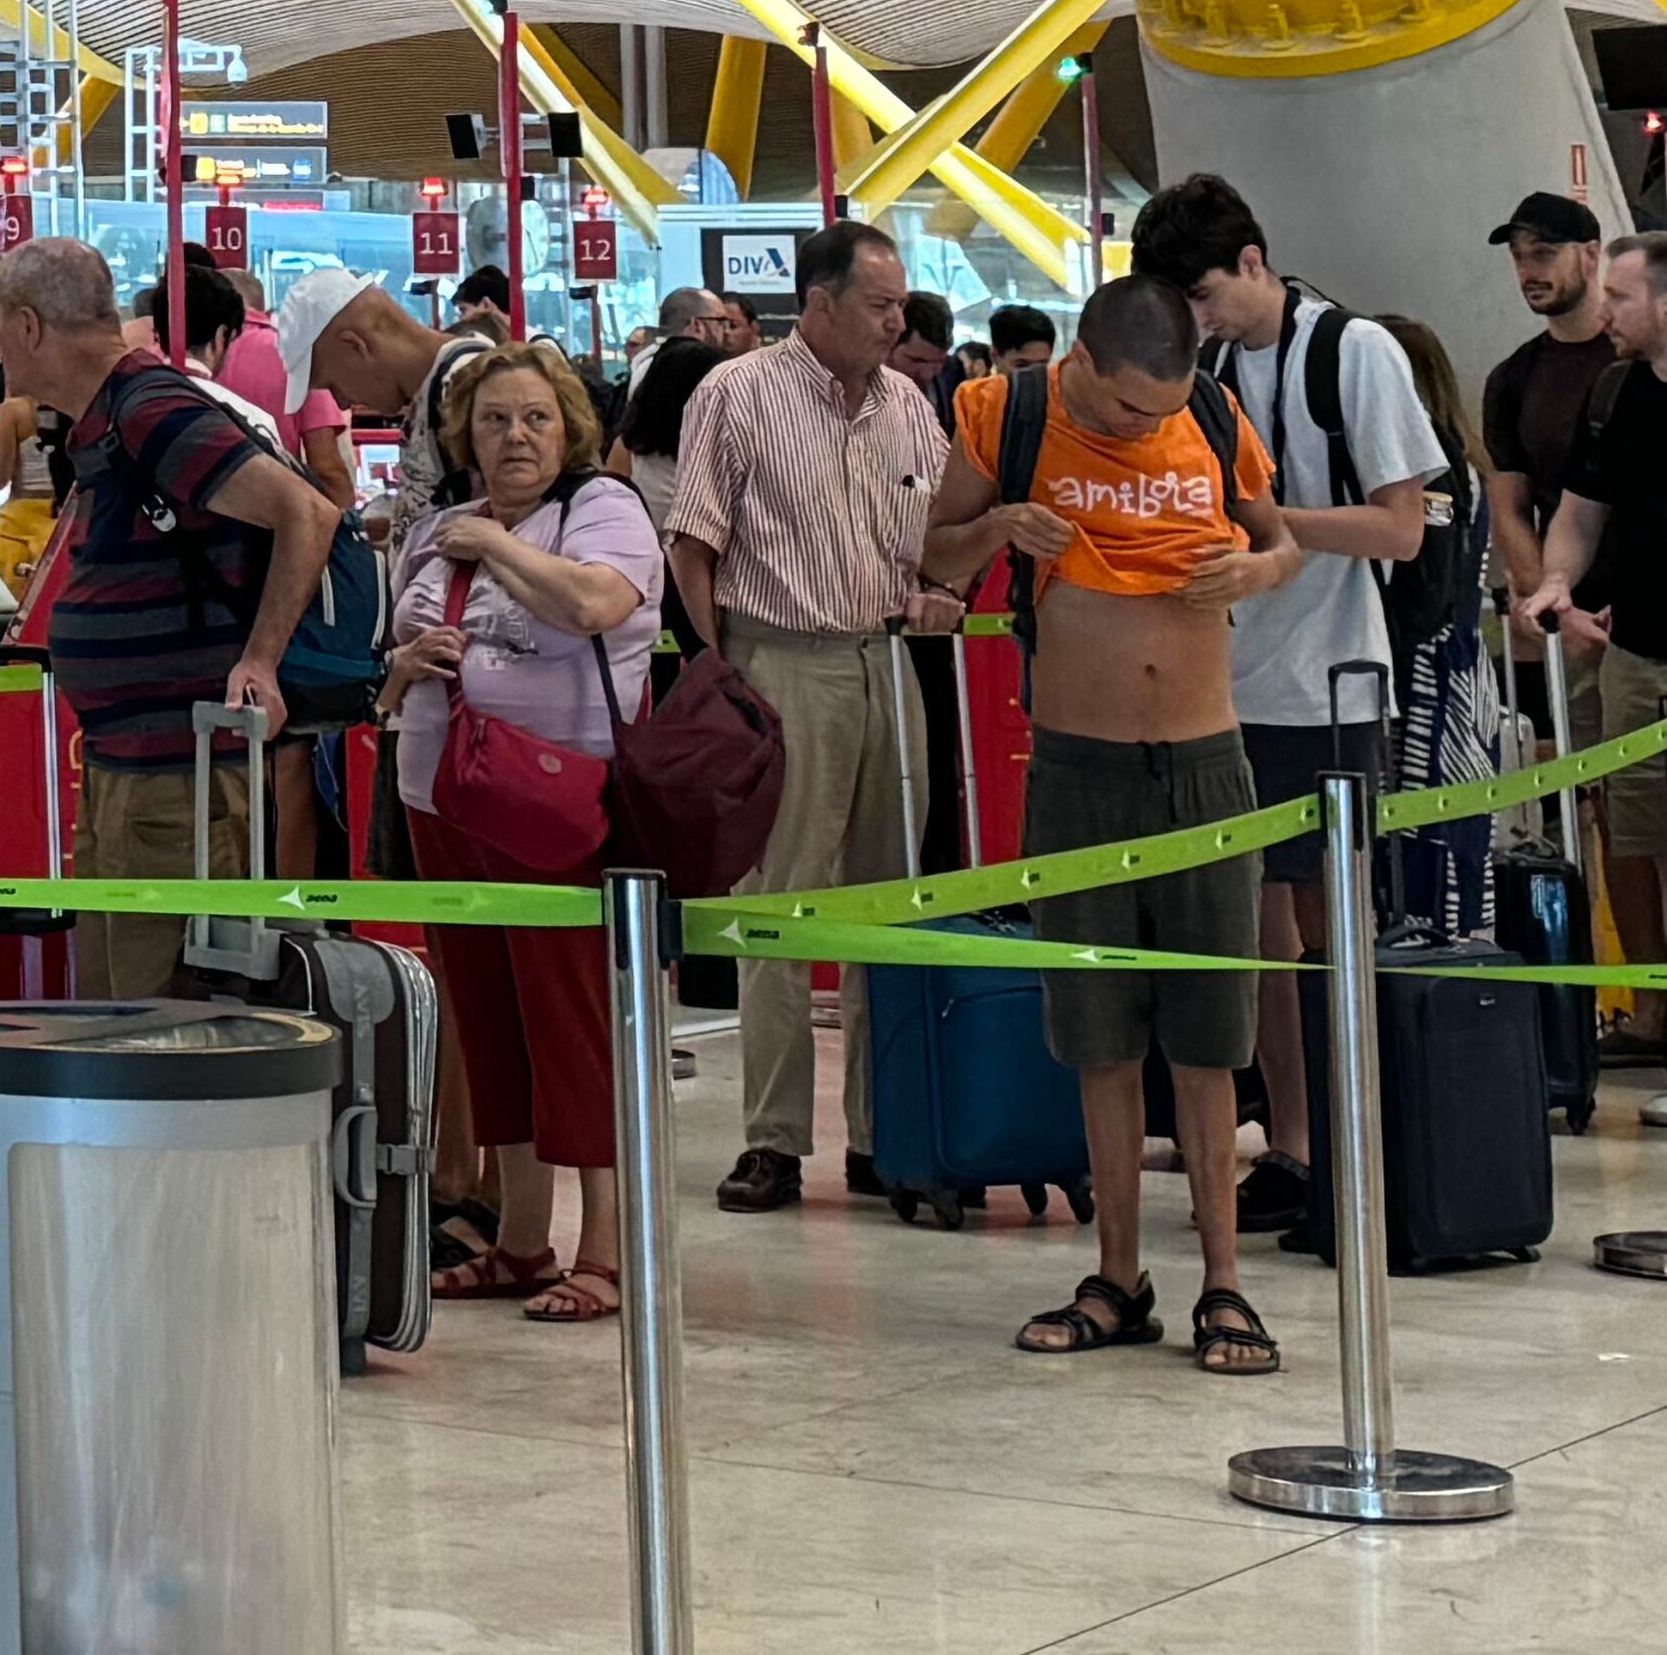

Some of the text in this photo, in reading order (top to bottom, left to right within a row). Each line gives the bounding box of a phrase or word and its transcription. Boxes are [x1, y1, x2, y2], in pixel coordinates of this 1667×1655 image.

[6, 217, 20, 240] 9
[212, 227, 242, 250] 10
[420, 232, 453, 255] 11
[580, 239, 611, 261] 12
